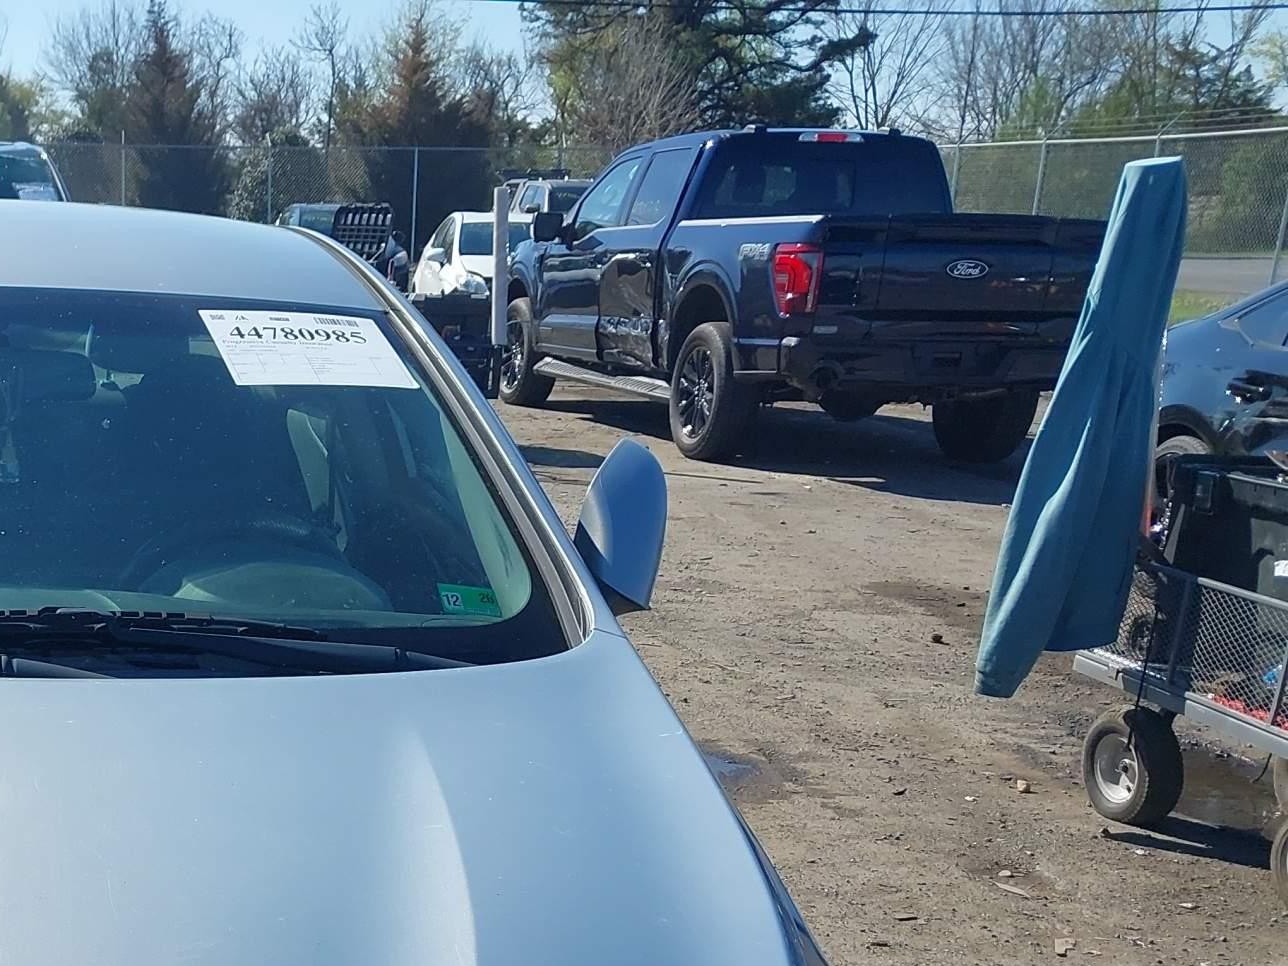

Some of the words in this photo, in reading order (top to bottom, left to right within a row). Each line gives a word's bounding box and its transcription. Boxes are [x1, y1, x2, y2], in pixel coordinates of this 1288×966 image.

[953, 262, 981, 275] Ford
[230, 325, 367, 344] 44780985
[442, 593, 463, 607] 12
